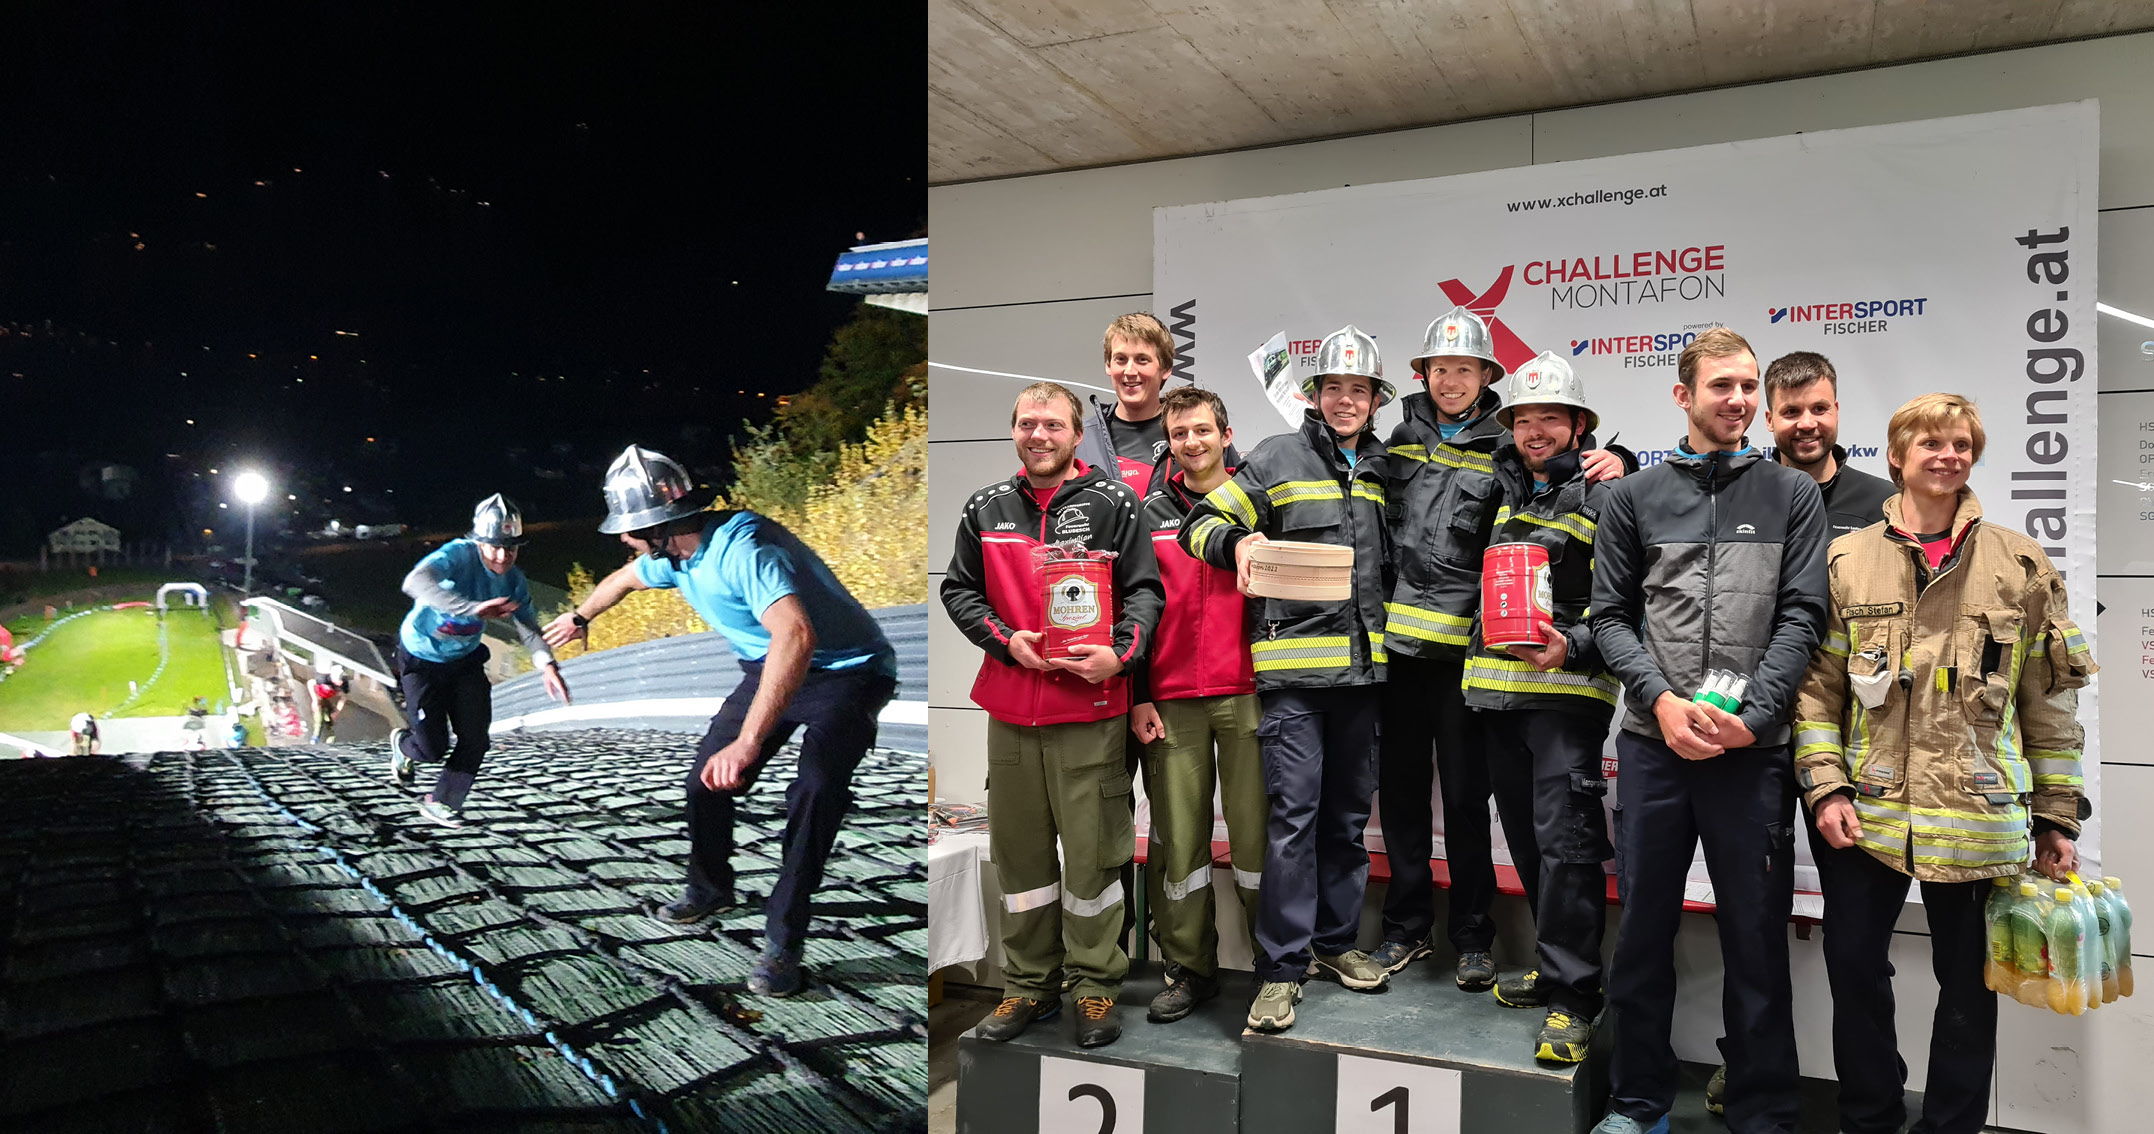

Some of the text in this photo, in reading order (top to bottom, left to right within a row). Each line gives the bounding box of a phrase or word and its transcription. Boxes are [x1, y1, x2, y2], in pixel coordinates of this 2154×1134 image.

[1507, 184, 1667, 212] www.xchallenge.at
[1523, 245, 1725, 286] CHALLENGE
[1552, 273, 1725, 310] MONTAFON
[1790, 298, 1927, 323] INTERSPORT
[1683, 321, 1713, 330] powered
[1824, 320, 1888, 335] FISCHER
[1592, 332, 1697, 355] INTERSPO
[1624, 353, 1681, 369] FISCHE
[994, 521, 1016, 530] JAKO
[1160, 518, 1181, 528] JAKO
[1053, 605, 1096, 615] MOHREN
[1867, 605, 1894, 615] Stefan
[1068, 1083, 1117, 1134] 2
[1370, 1085, 1410, 1134] 1
